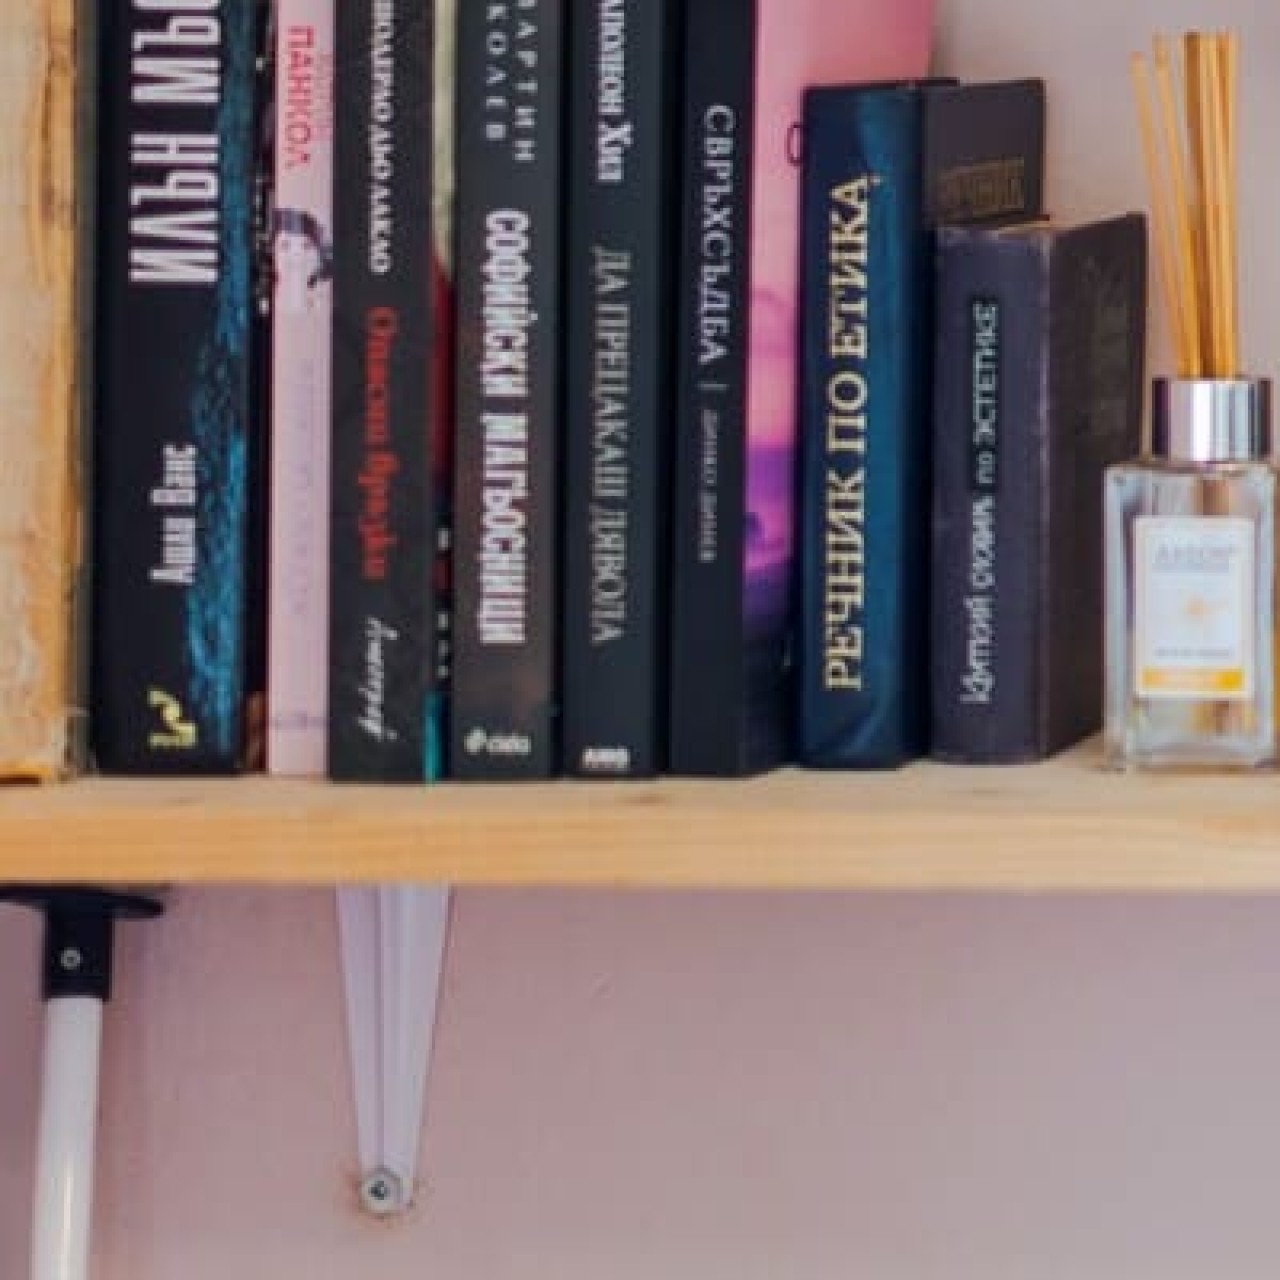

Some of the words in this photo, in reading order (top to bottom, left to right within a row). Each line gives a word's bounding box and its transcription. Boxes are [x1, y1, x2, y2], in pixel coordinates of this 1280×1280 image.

[287, 26, 314, 163] ПАНКОЛ
[486, 5, 506, 139] КОЛЕВ
[131, 134, 219, 282] ИЛЪН
[596, 248, 629, 292] ДА
[700, 105, 733, 363] СВРЪХСЪДБА
[828, 175, 869, 358] ЕТИКА
[481, 210, 537, 396] СОФИЙСКИ
[595, 304, 629, 496] ПРЕЦАКАШ
[828, 370, 868, 453] ПО
[151, 445, 197, 505] Ванс
[478, 413, 527, 643] МАГЬОСНИЦИ
[592, 508, 626, 641] ДЯВОЛА
[826, 468, 865, 689] РЕЧНИК
